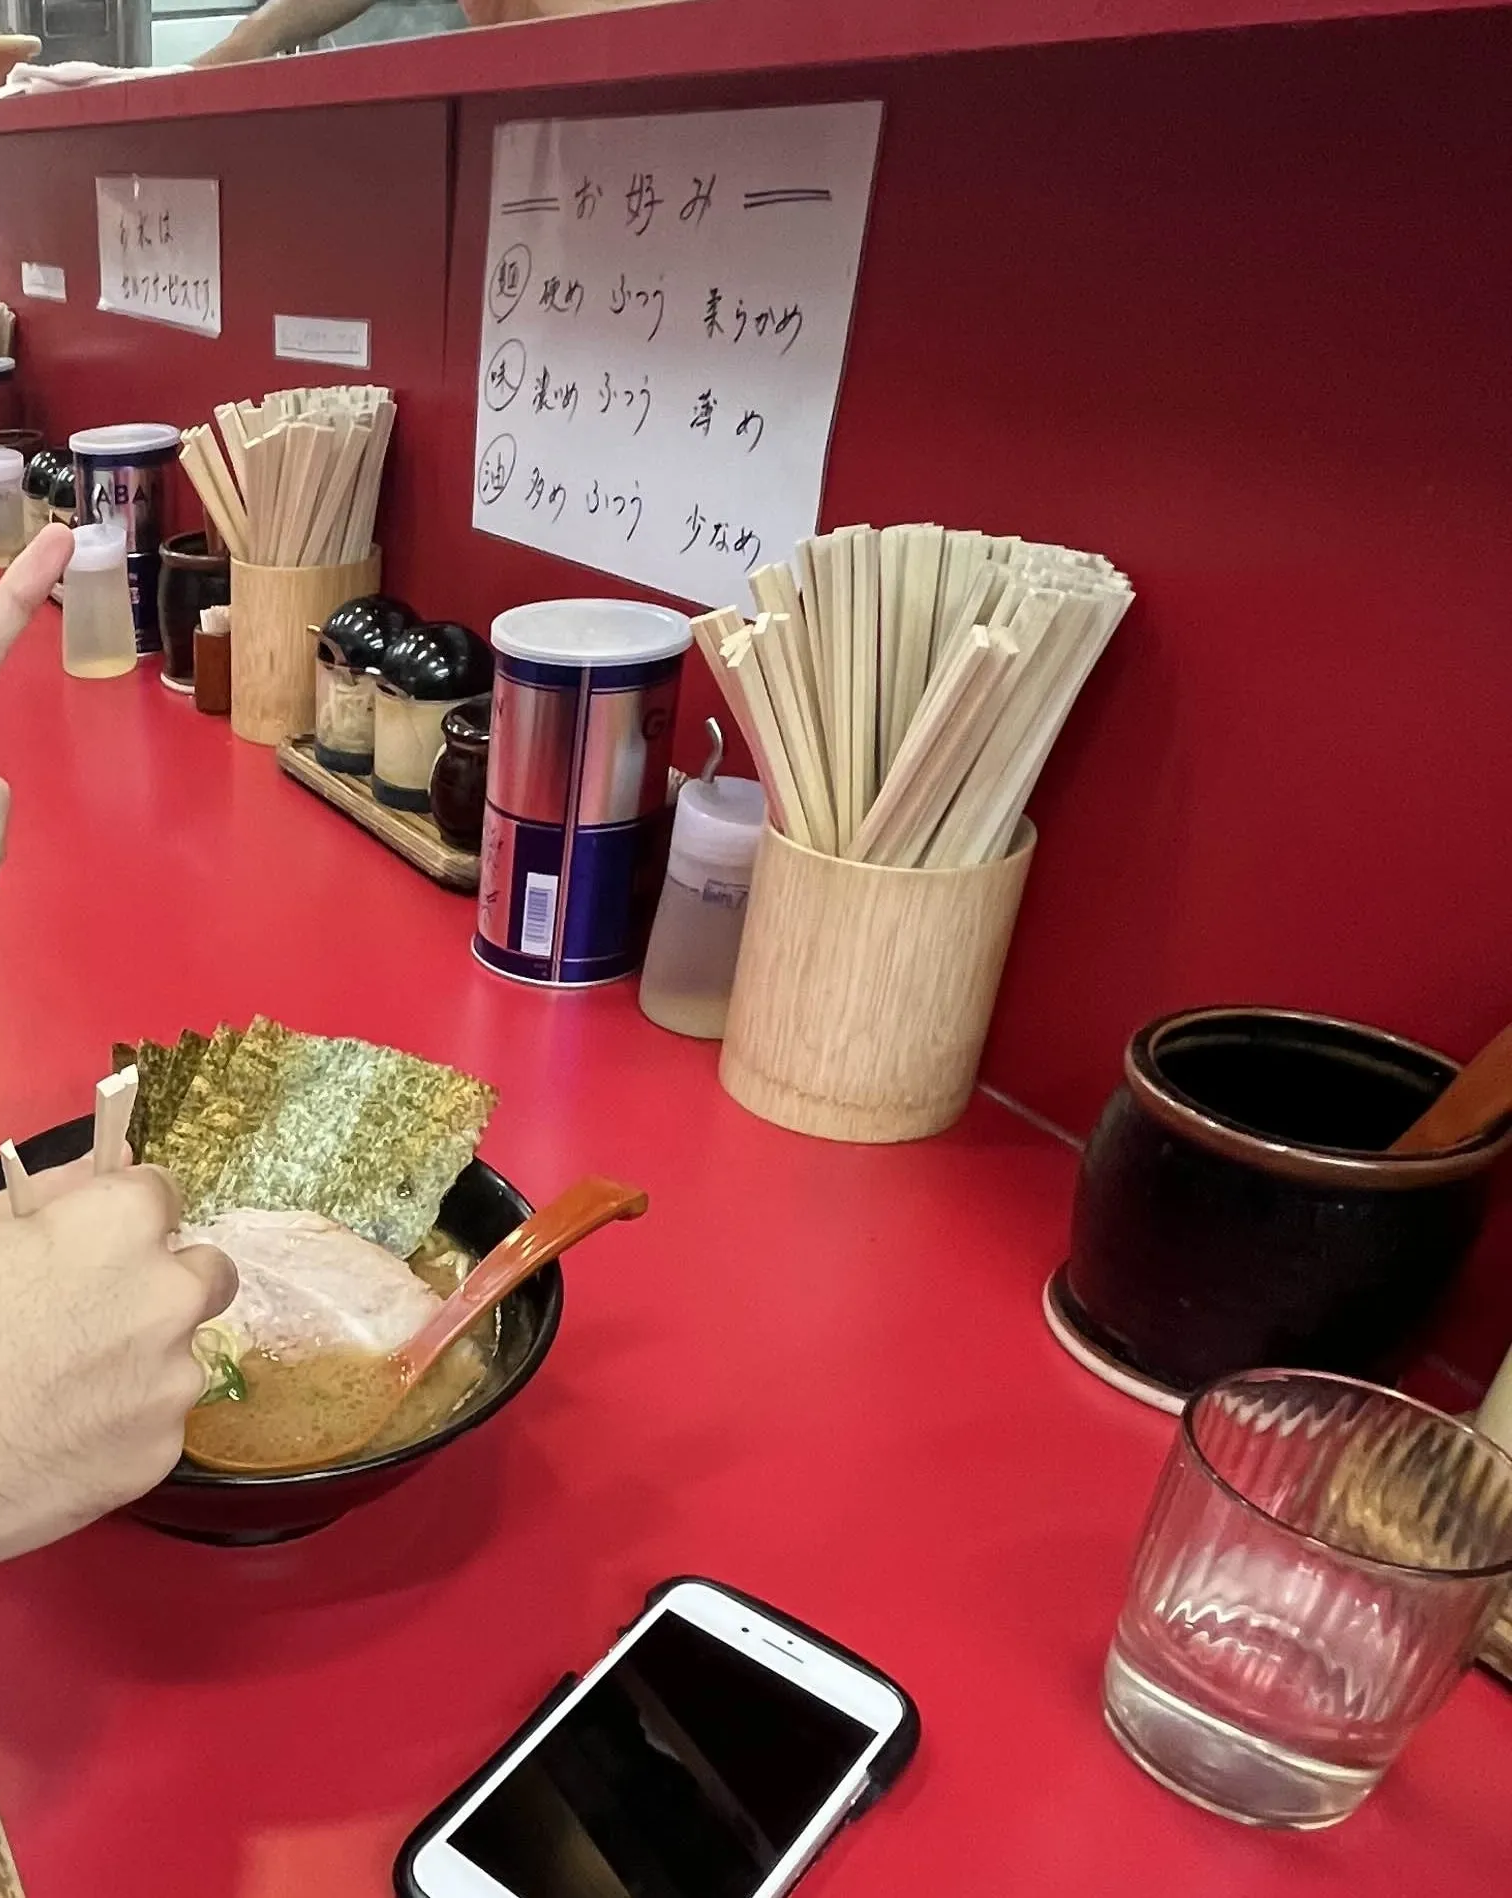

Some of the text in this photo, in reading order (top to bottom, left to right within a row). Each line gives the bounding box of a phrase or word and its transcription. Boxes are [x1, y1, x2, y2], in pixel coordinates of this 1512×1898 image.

[574, 173, 717, 237] お好み
[539, 276, 585, 317] 硬め
[609, 273, 665, 342] ふつう
[703, 287, 803, 356] 柔らかめ
[599, 371, 651, 436] ふつう
[689, 388, 765, 453] 薄め
[524, 466, 567, 525] 多め
[586, 479, 643, 541] ふつう
[680, 503, 762, 573] 少なめ
